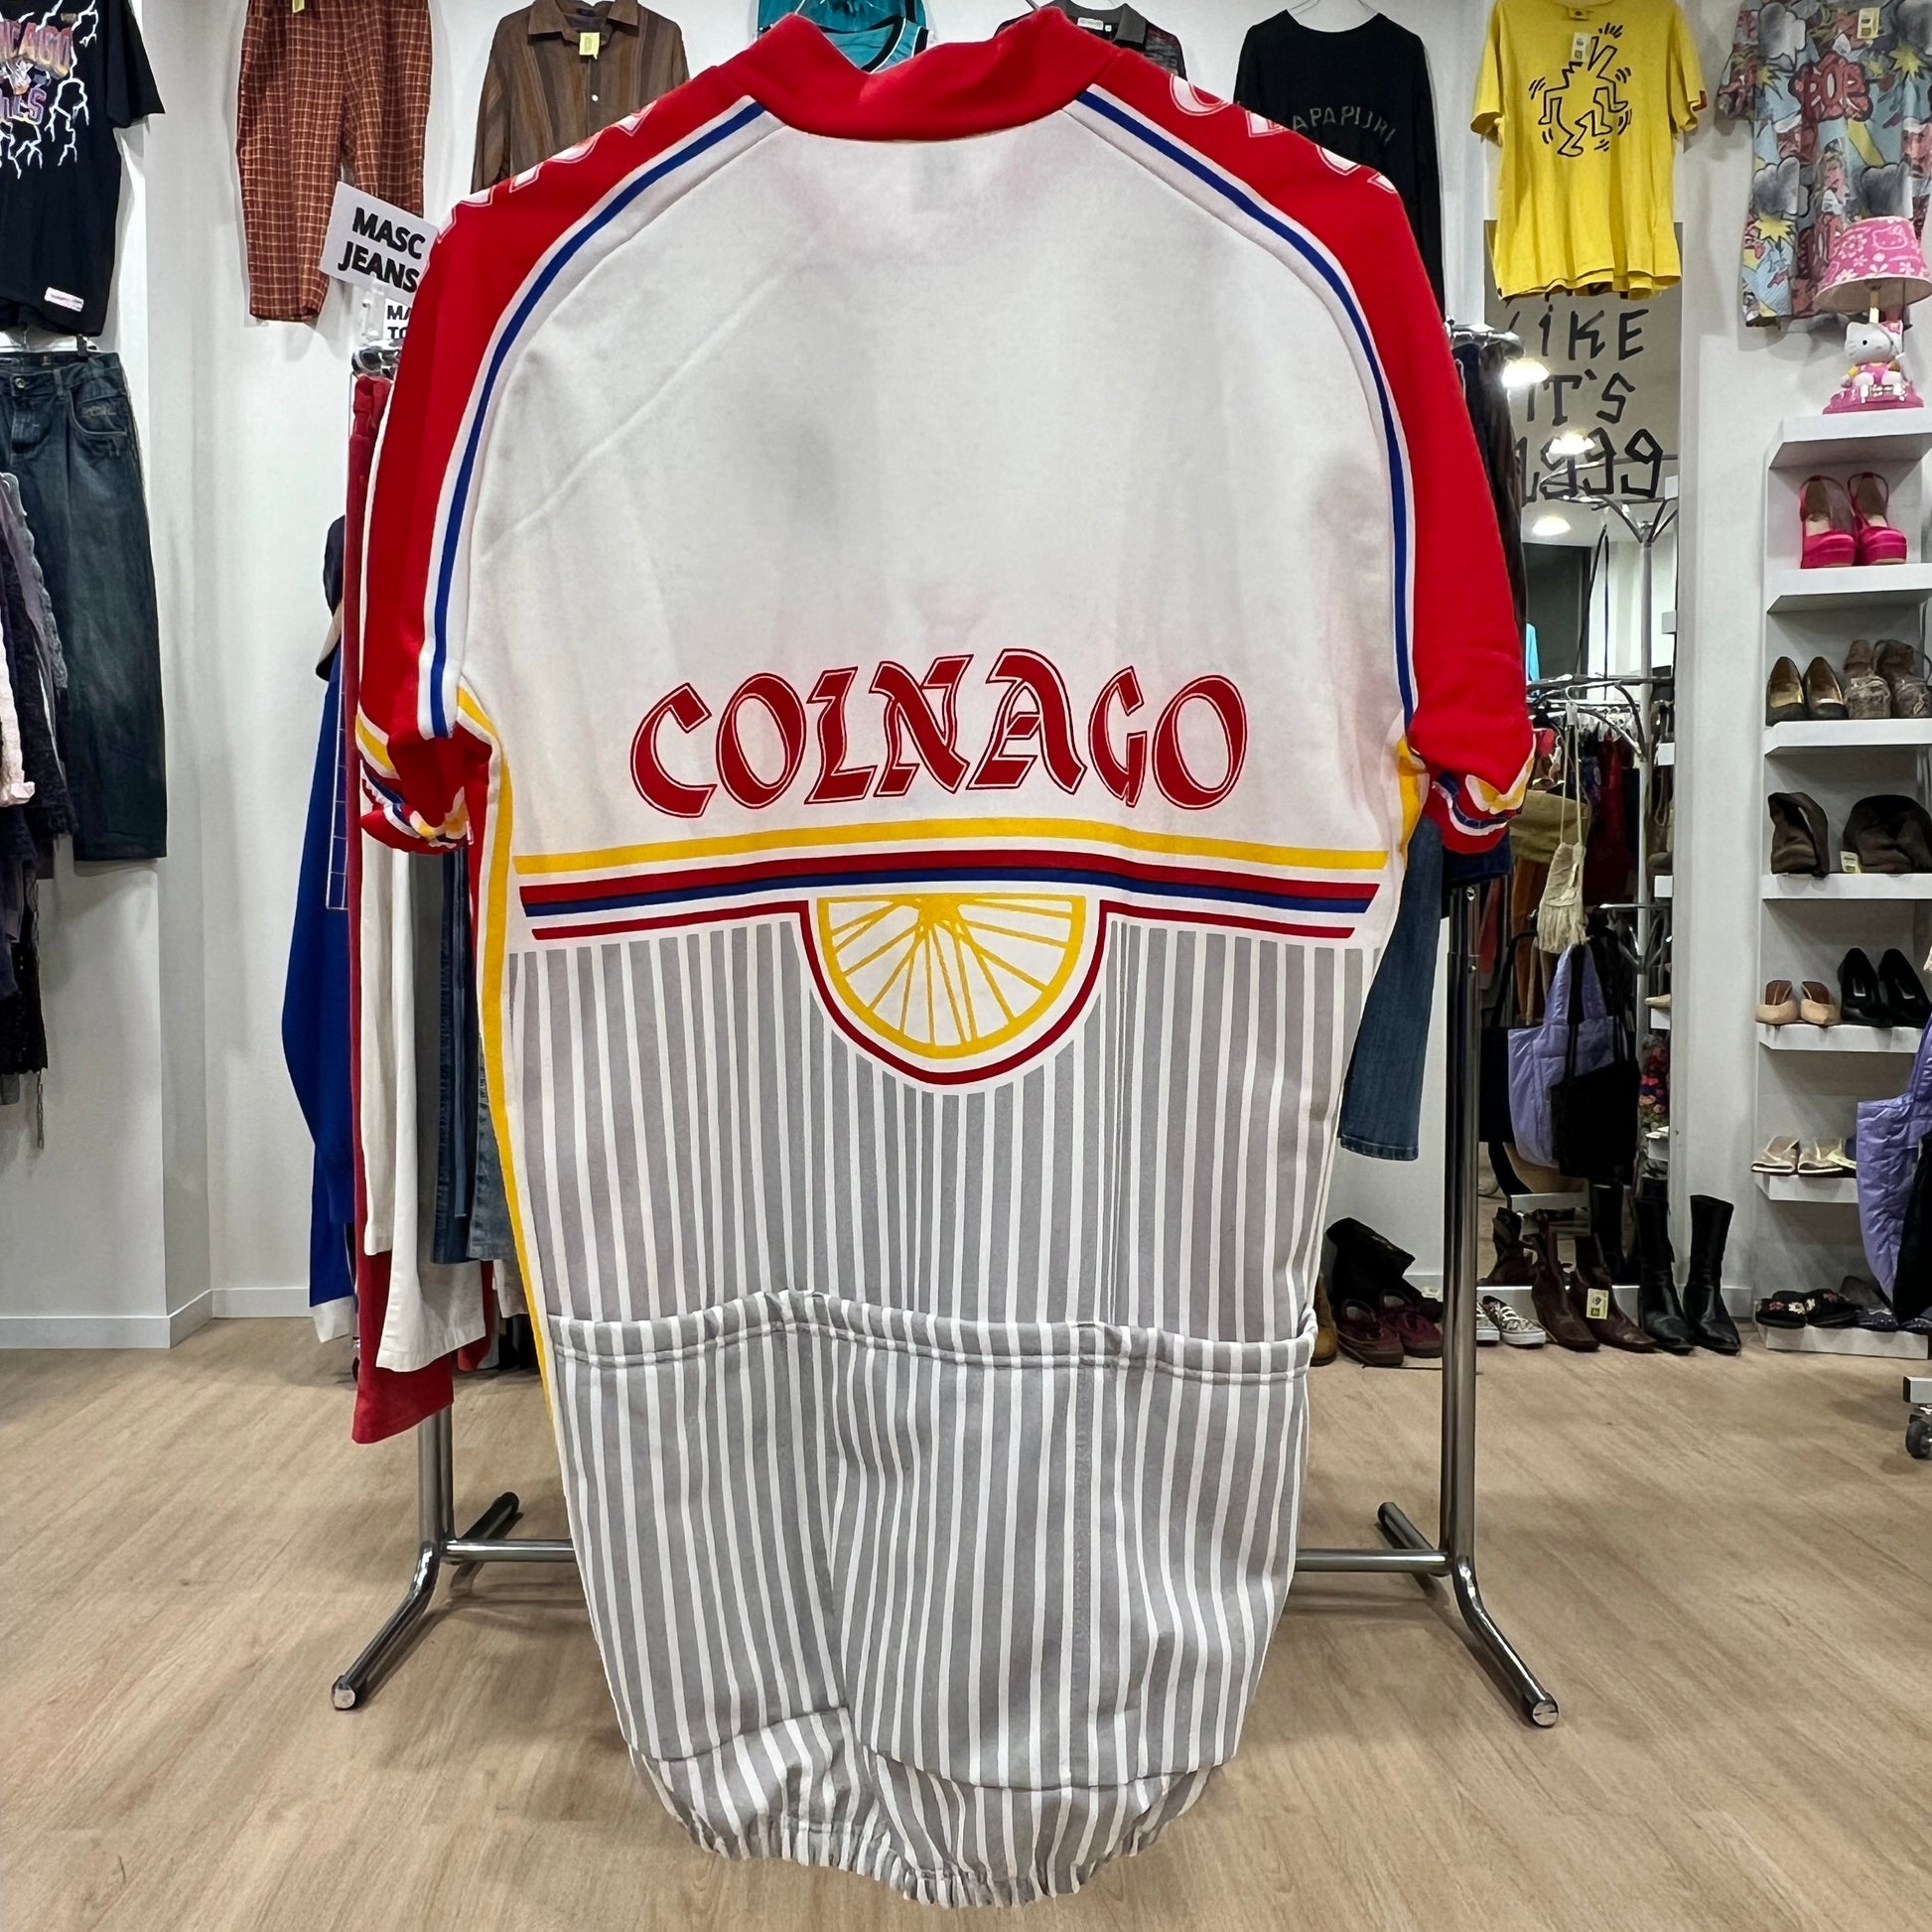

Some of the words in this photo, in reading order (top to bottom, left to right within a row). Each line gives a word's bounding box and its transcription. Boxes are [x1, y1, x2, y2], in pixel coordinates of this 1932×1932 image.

[1293, 105, 1396, 144] APAPIJRI
[351, 207, 426, 260] MASC
[338, 240, 420, 293] JEANS
[1515, 427, 1664, 507] 1999
[630, 648, 1248, 818] COLNAGO
